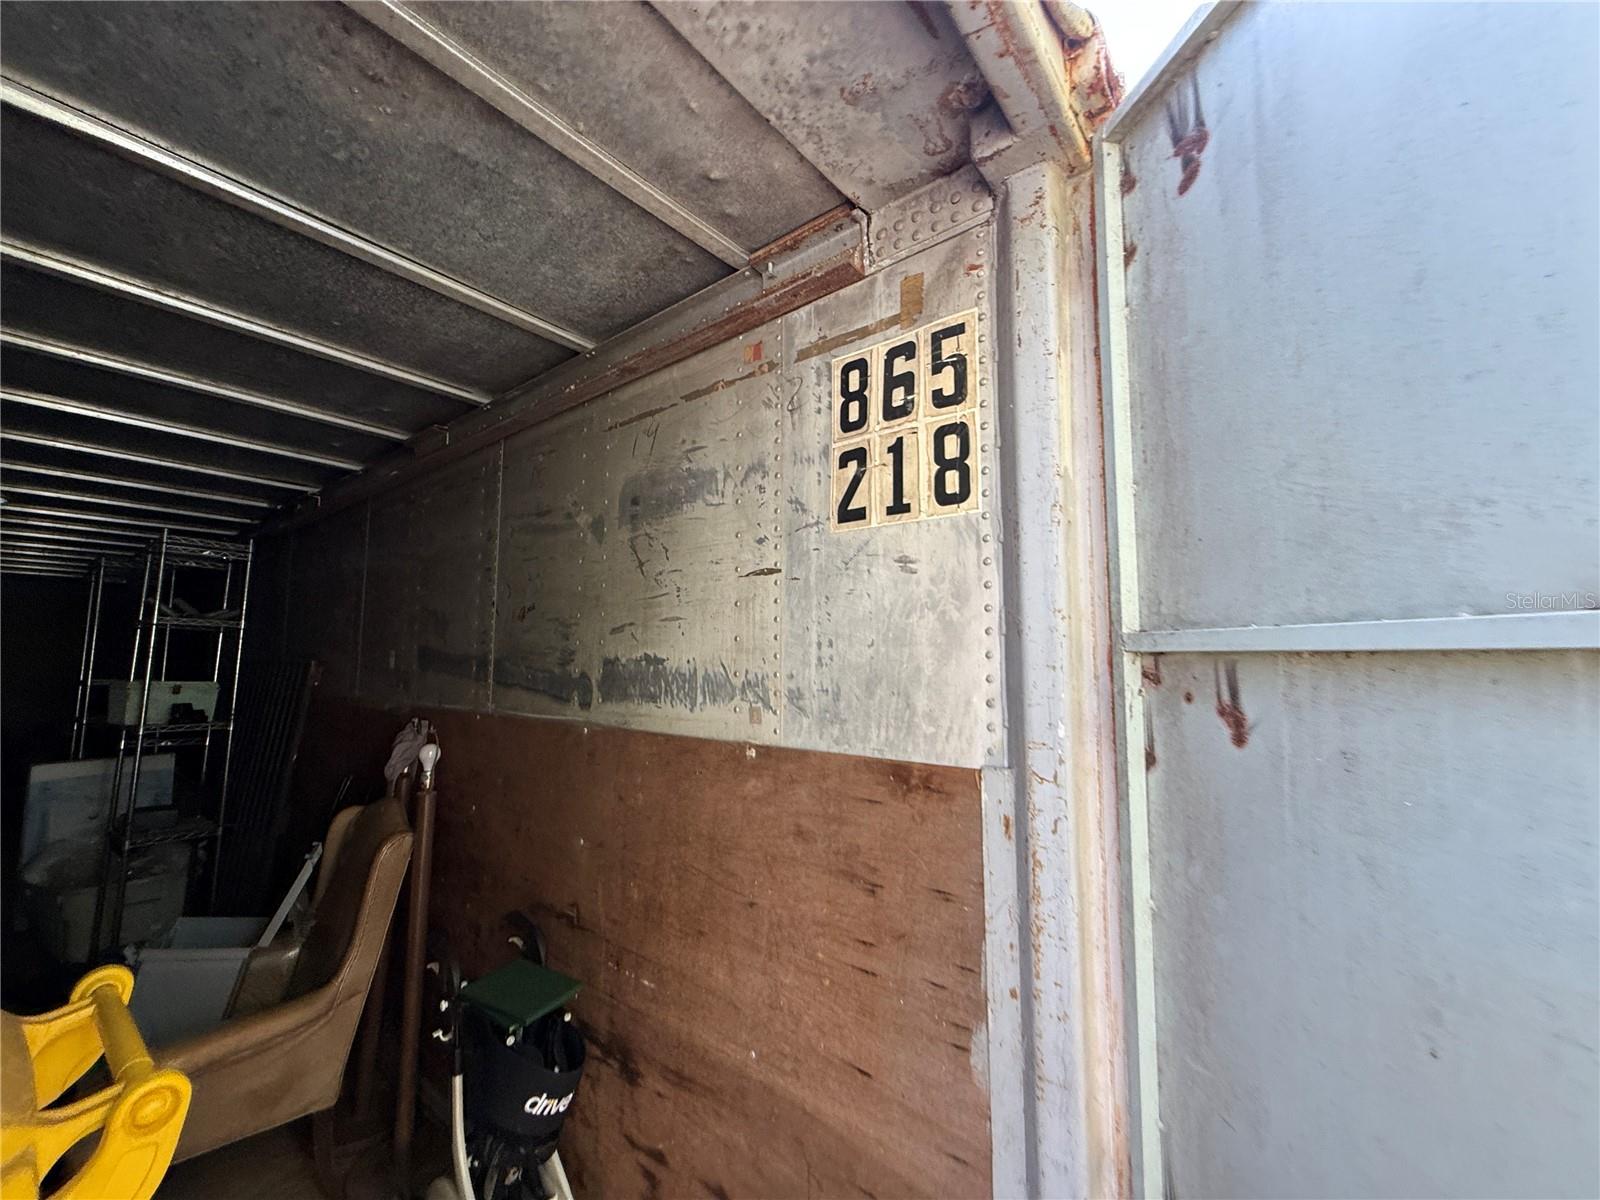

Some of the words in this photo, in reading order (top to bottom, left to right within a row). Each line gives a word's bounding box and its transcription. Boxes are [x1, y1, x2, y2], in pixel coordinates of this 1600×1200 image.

[840, 322, 968, 434] 865
[837, 421, 971, 524] 218
[524, 1092, 574, 1116] drive
